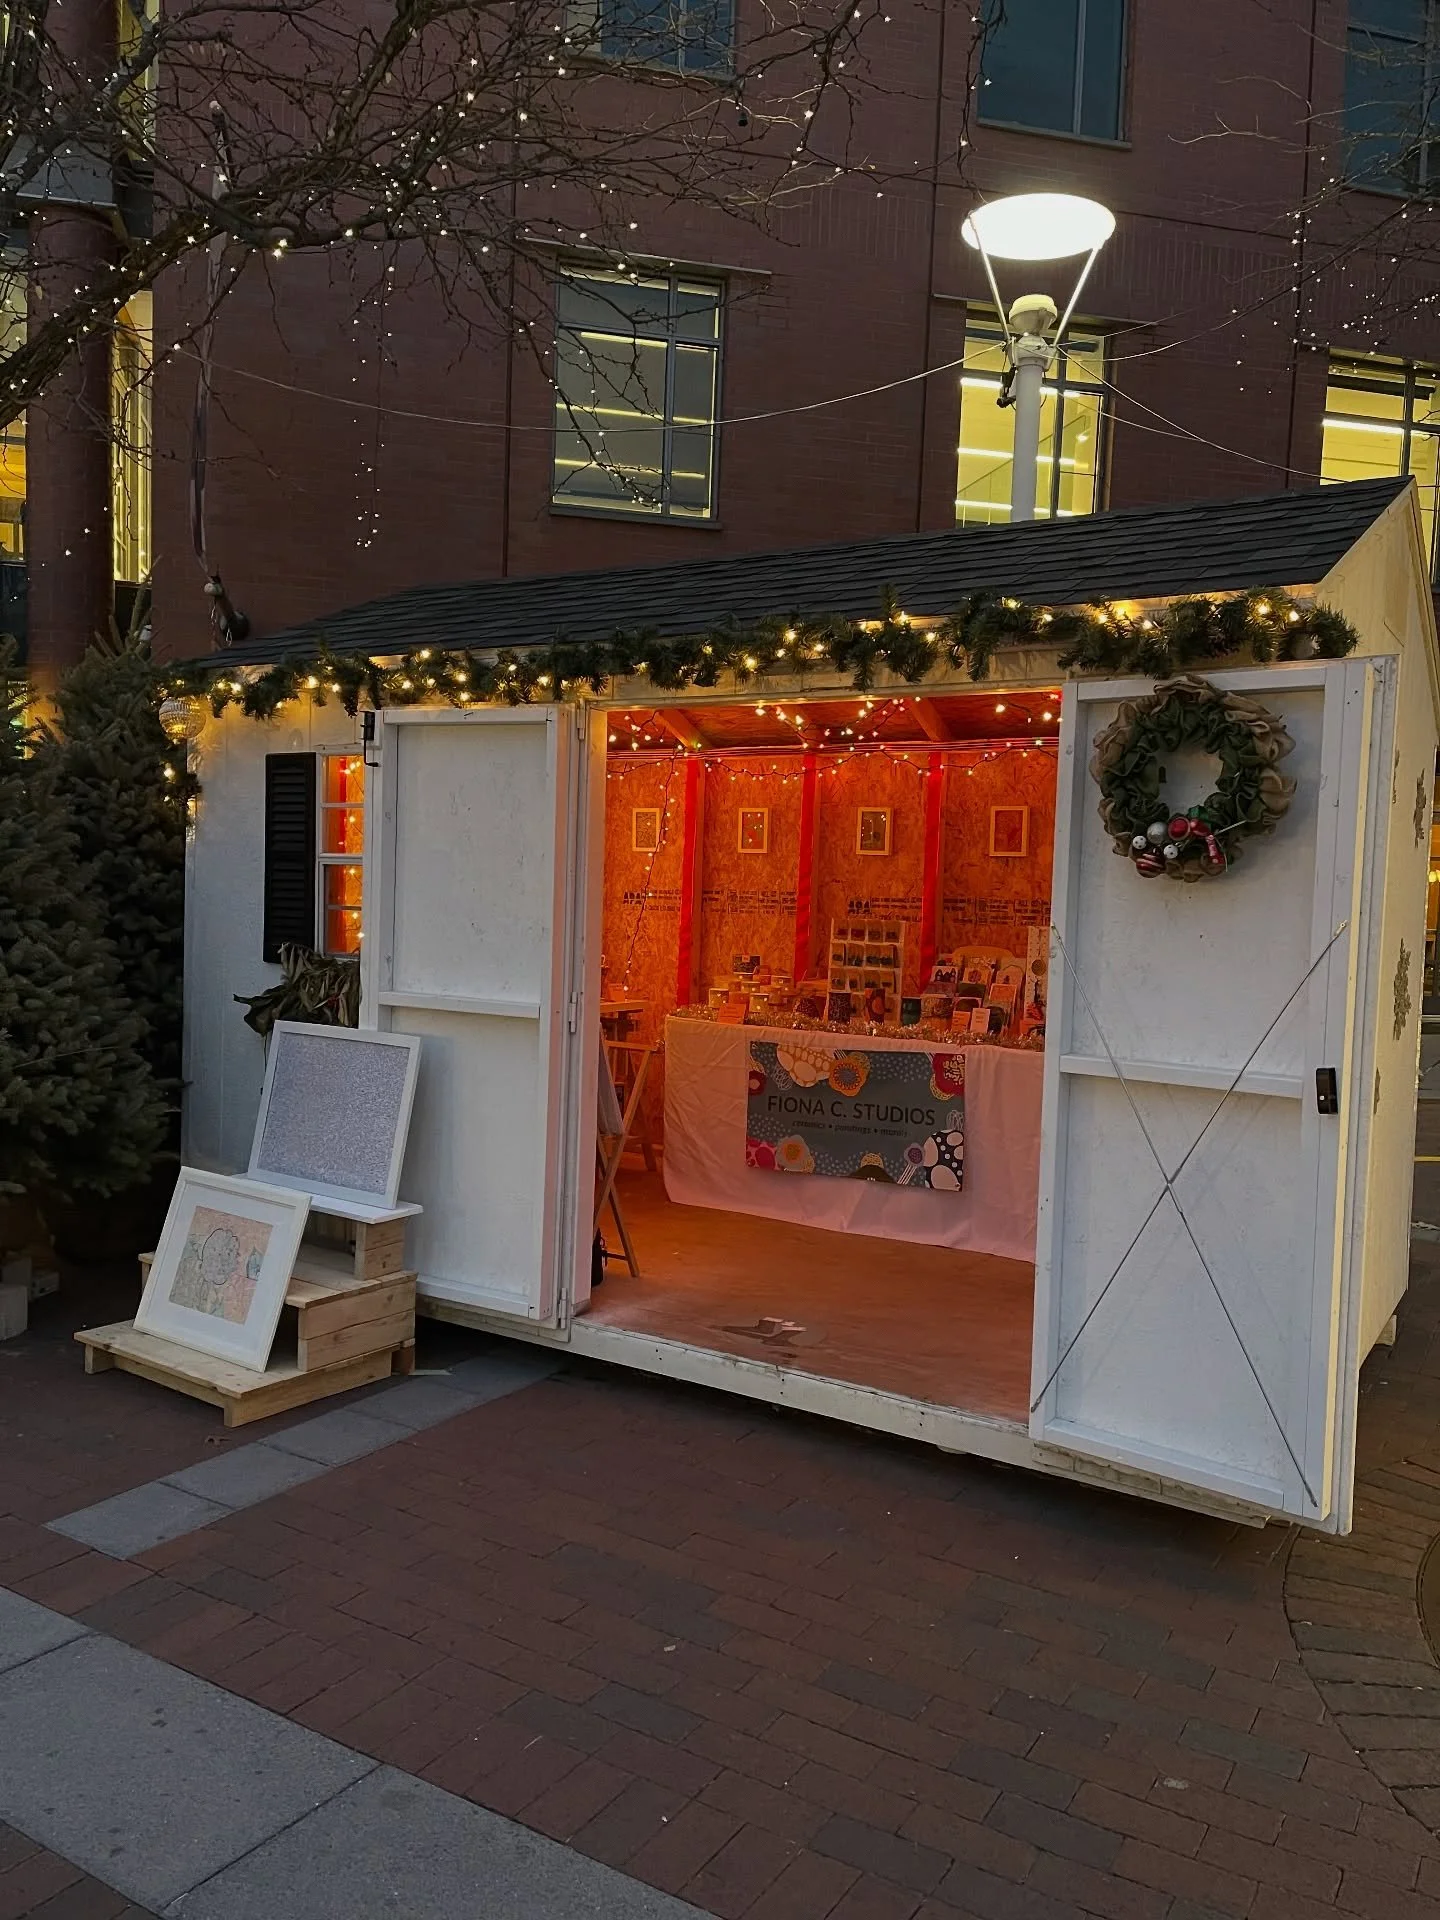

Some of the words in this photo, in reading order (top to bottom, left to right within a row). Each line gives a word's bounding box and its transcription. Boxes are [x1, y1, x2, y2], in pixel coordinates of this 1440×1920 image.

[767, 1095, 825, 1115] FIONA
[830, 1100, 847, 1118] C.
[853, 1103, 936, 1126] STUDIOS
